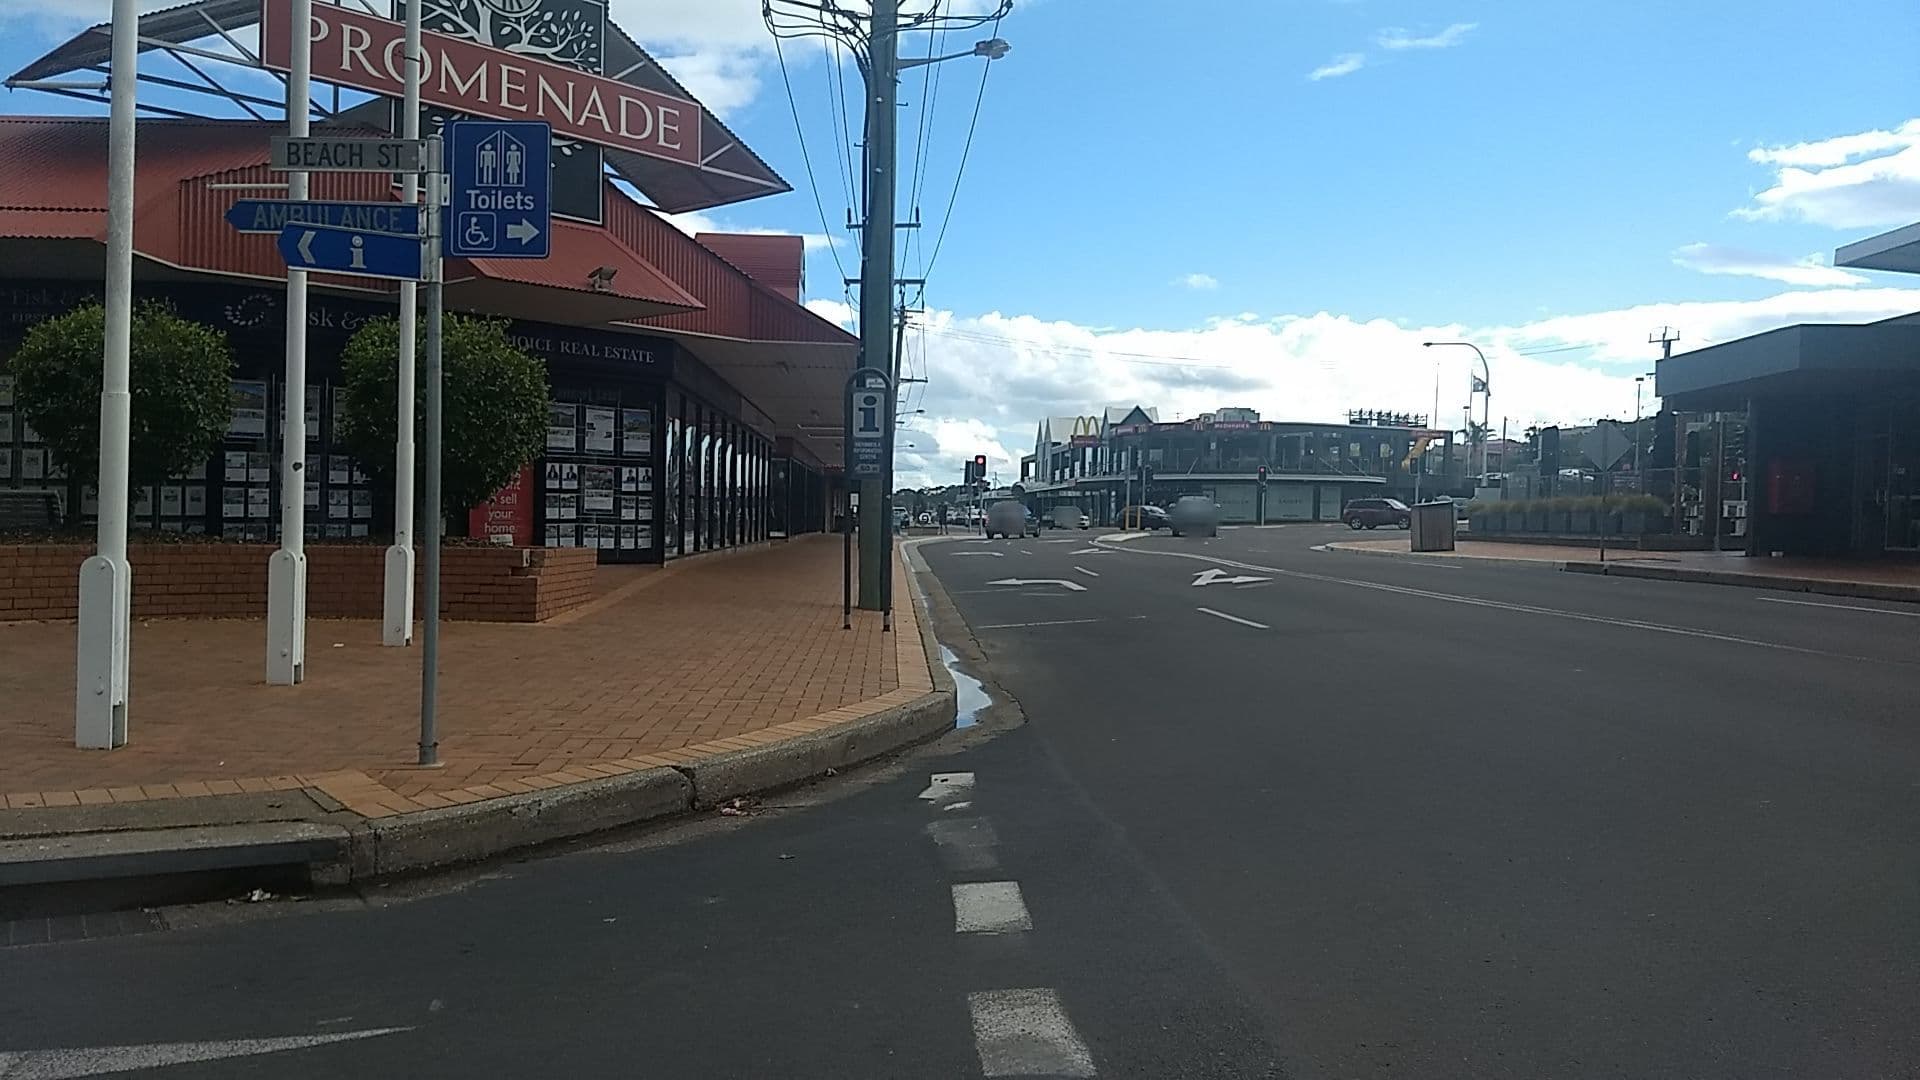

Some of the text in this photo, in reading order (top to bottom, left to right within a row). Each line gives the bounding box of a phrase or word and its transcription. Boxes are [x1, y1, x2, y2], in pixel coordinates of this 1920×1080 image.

[311, 16, 682, 152] PROMENADE
[286, 141, 404, 168] BEACH ST
[465, 189, 535, 210] Toilets
[253, 203, 404, 233] AMBULANCE
[560, 340, 600, 358] REAL
[604, 345, 656, 364] ESTATE
[500, 493, 517, 505] sell
[488, 509, 514, 523] your
